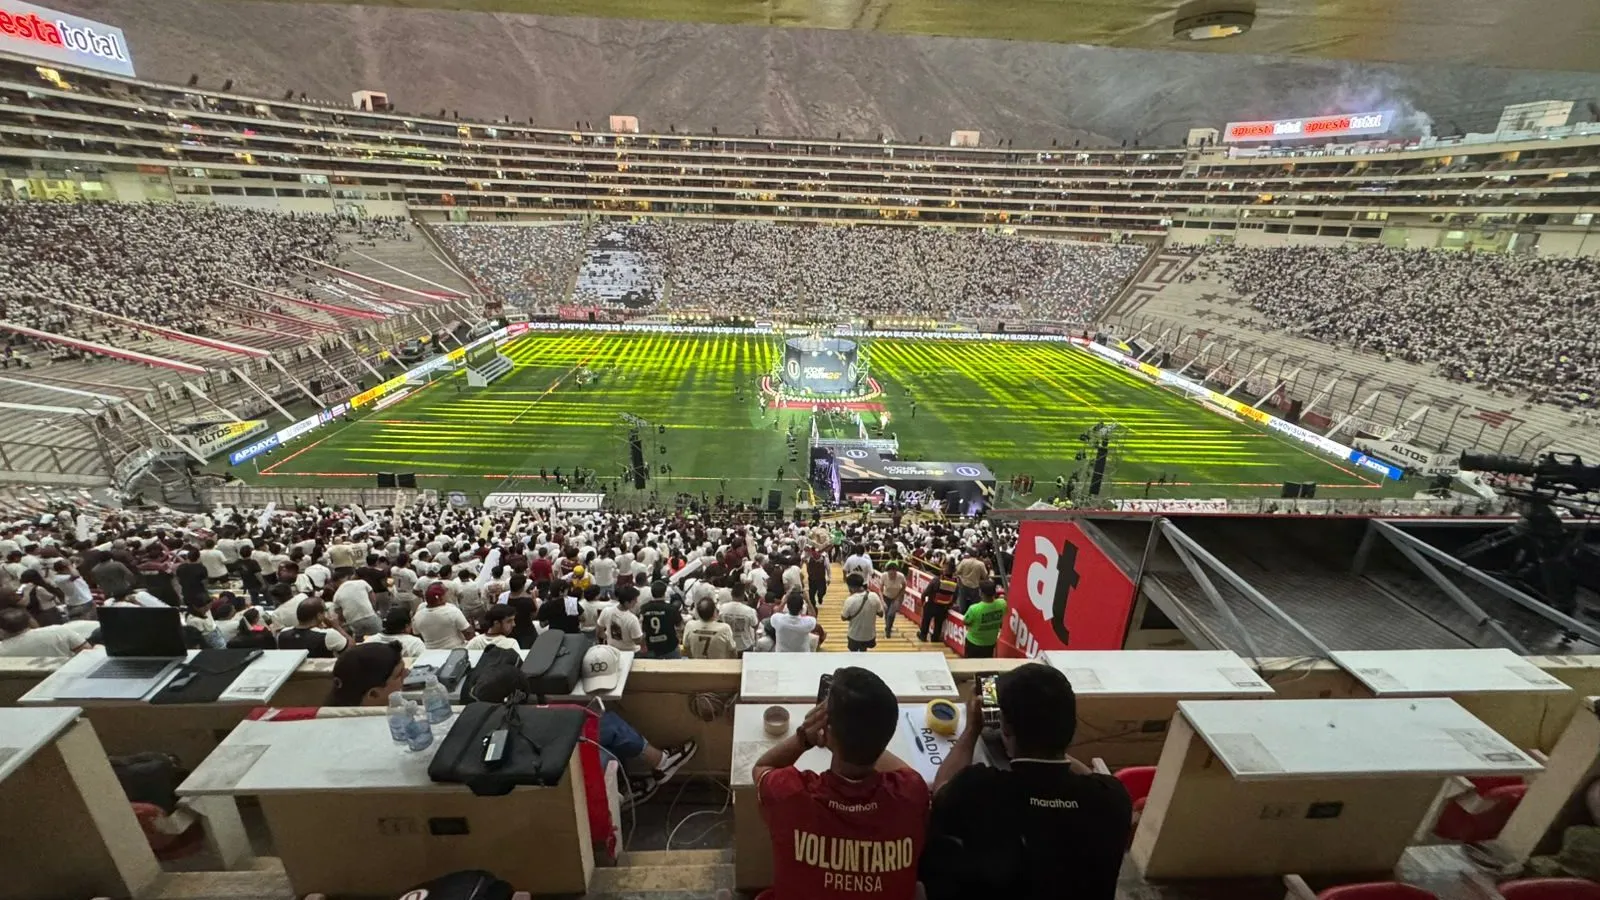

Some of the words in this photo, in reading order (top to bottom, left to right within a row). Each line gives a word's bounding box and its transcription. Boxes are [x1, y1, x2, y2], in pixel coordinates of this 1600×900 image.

[1391, 444, 1428, 464] ALTOS
[650, 617, 661, 635] 9
[699, 636, 712, 656] 7
[920, 728, 943, 766] RADIO
[828, 799, 878, 812] marathon
[1029, 797, 1079, 808] marathon
[793, 828, 913, 873] VOLUNTARIO
[824, 871, 883, 893] PRENSA
